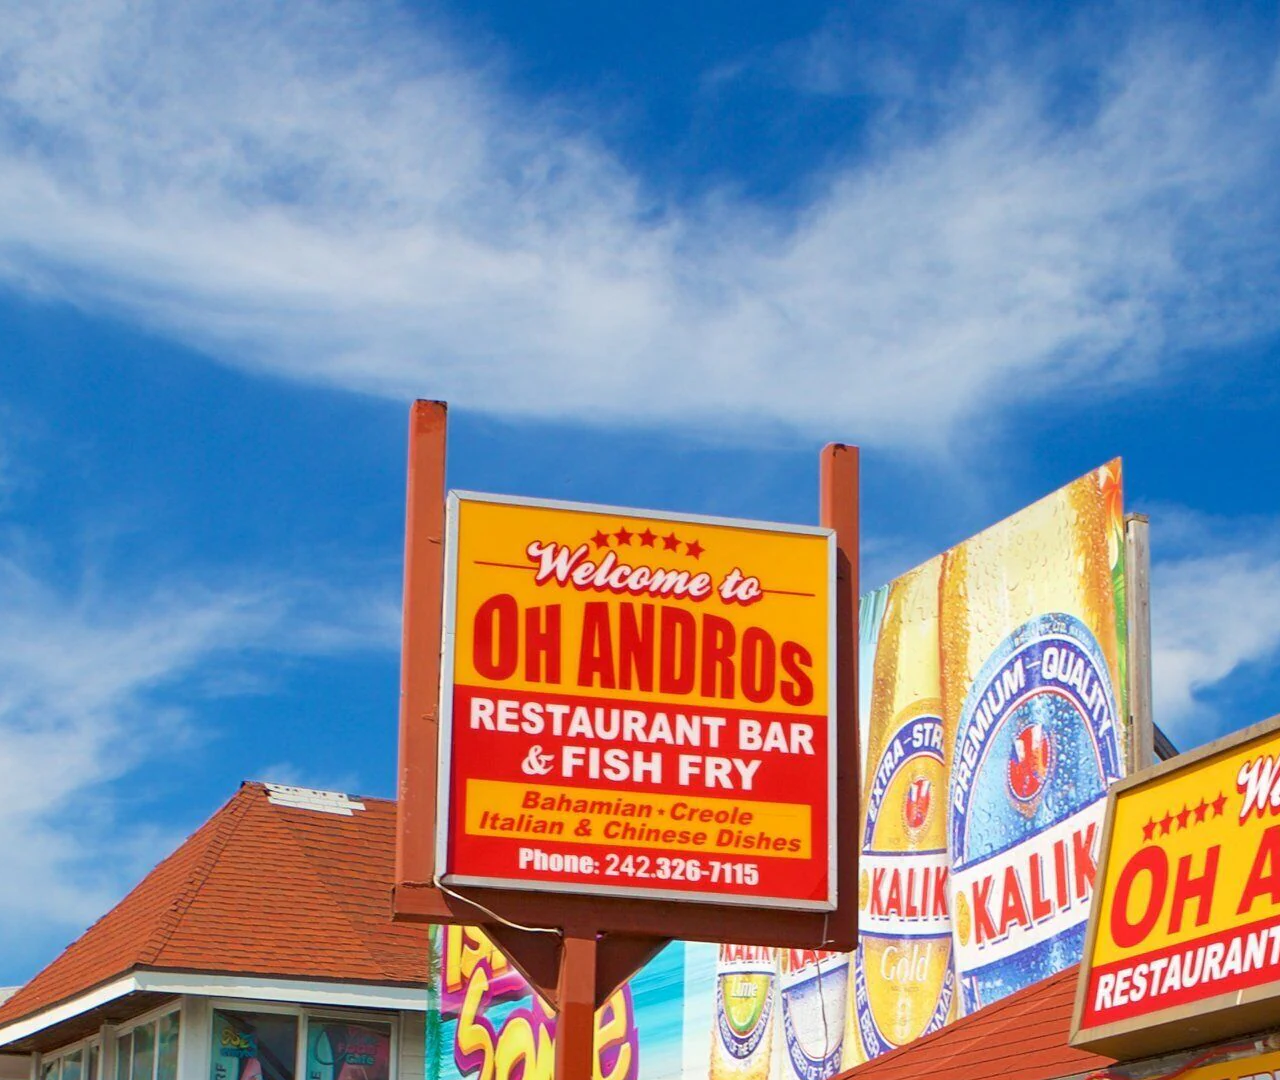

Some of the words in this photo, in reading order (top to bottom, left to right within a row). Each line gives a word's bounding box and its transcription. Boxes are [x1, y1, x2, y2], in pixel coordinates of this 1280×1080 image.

[527, 540, 713, 599] Welcome
[719, 567, 762, 603] to
[473, 593, 561, 685] OH
[577, 601, 814, 707] ANDROS
[470, 696, 726, 749] RESTAURANT
[738, 718, 815, 756] BAR
[521, 744, 555, 776] &
[561, 745, 663, 784] FISH
[678, 754, 762, 791] FRY
[478, 809, 564, 836] Italian
[574, 818, 593, 837] &
[603, 819, 707, 846] Chinese
[715, 827, 802, 853] Dishes
[522, 789, 652, 819] Bahamian
[670, 801, 754, 827] Creole
[519, 846, 600, 876] Phone:
[605, 853, 760, 886] 242.326-7115
[972, 821, 1098, 947] KALIK
[870, 867, 951, 919] KALIK
[1110, 844, 1220, 949] OH
[880, 942, 933, 985] Gold
